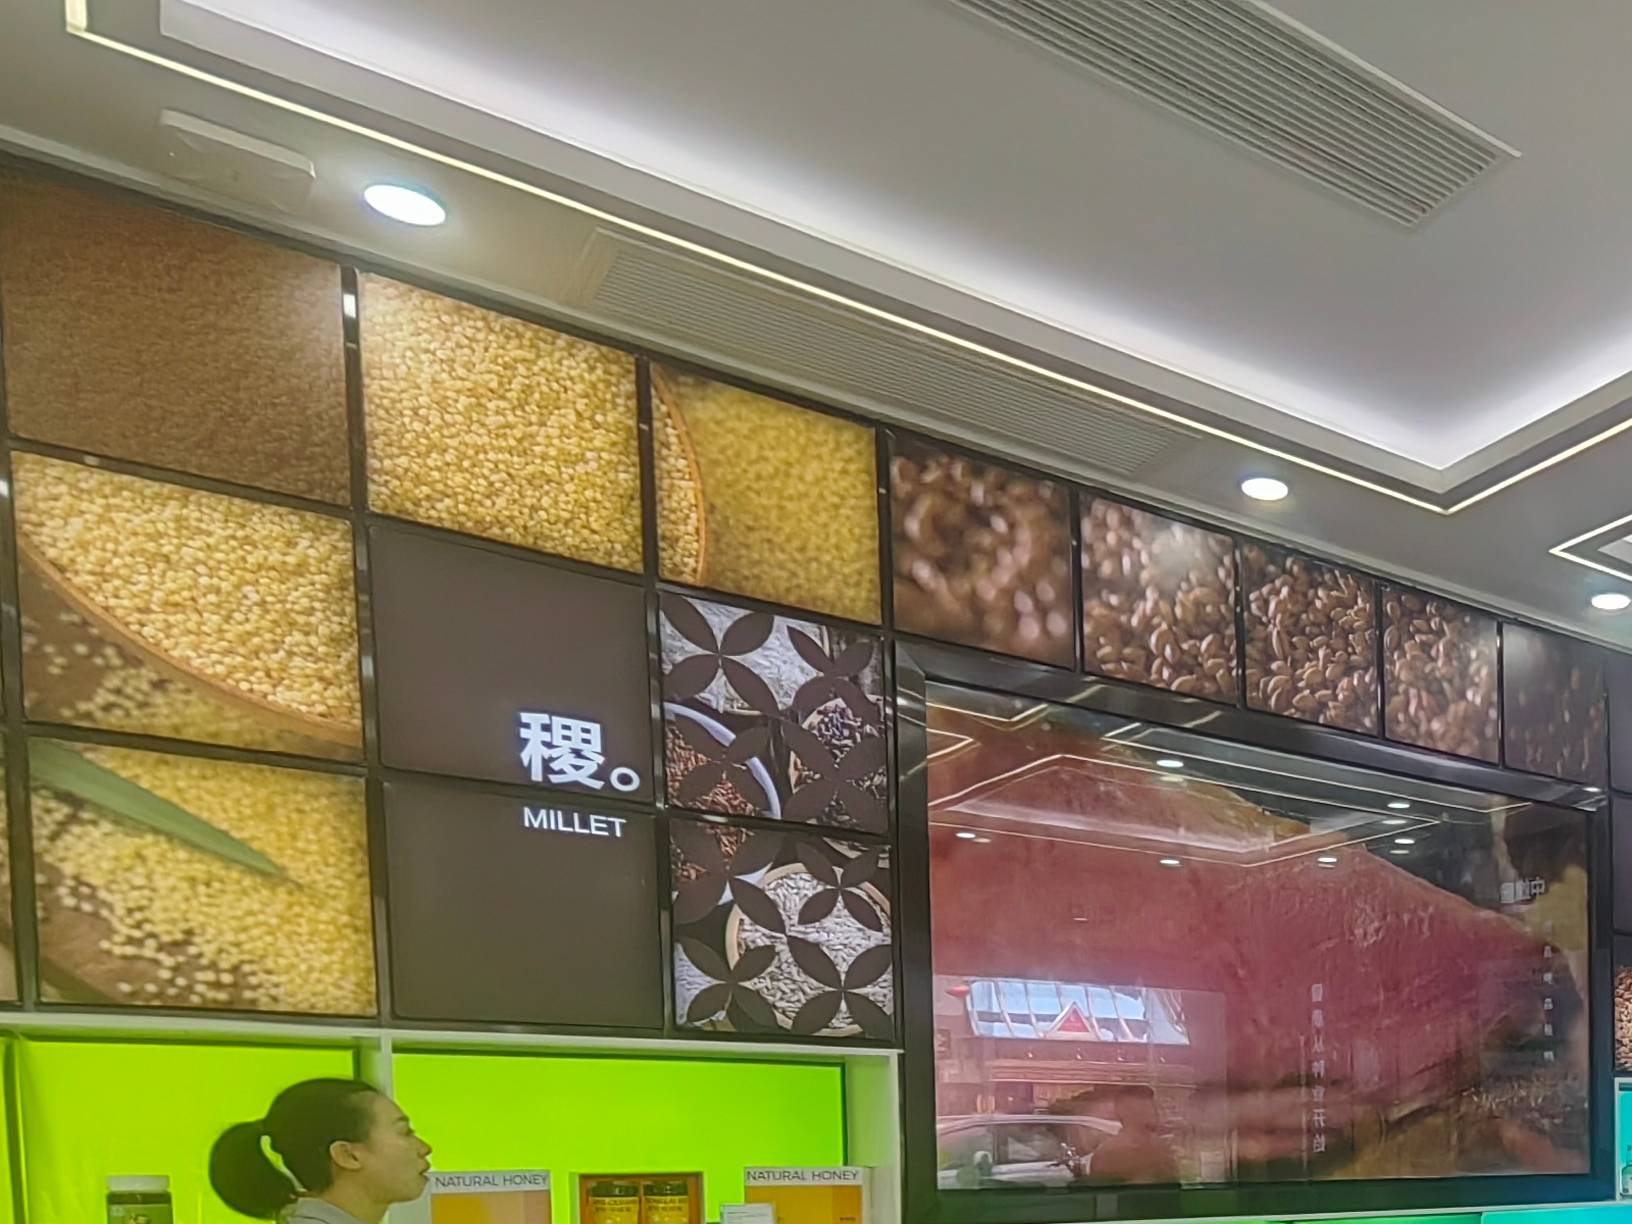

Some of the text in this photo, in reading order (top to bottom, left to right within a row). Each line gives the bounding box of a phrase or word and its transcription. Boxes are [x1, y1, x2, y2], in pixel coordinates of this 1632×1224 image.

[522, 806, 627, 838] MILLET
[434, 1173, 548, 1188] NATURAL HONEY
[746, 1169, 859, 1182] NATURAL HONEY
